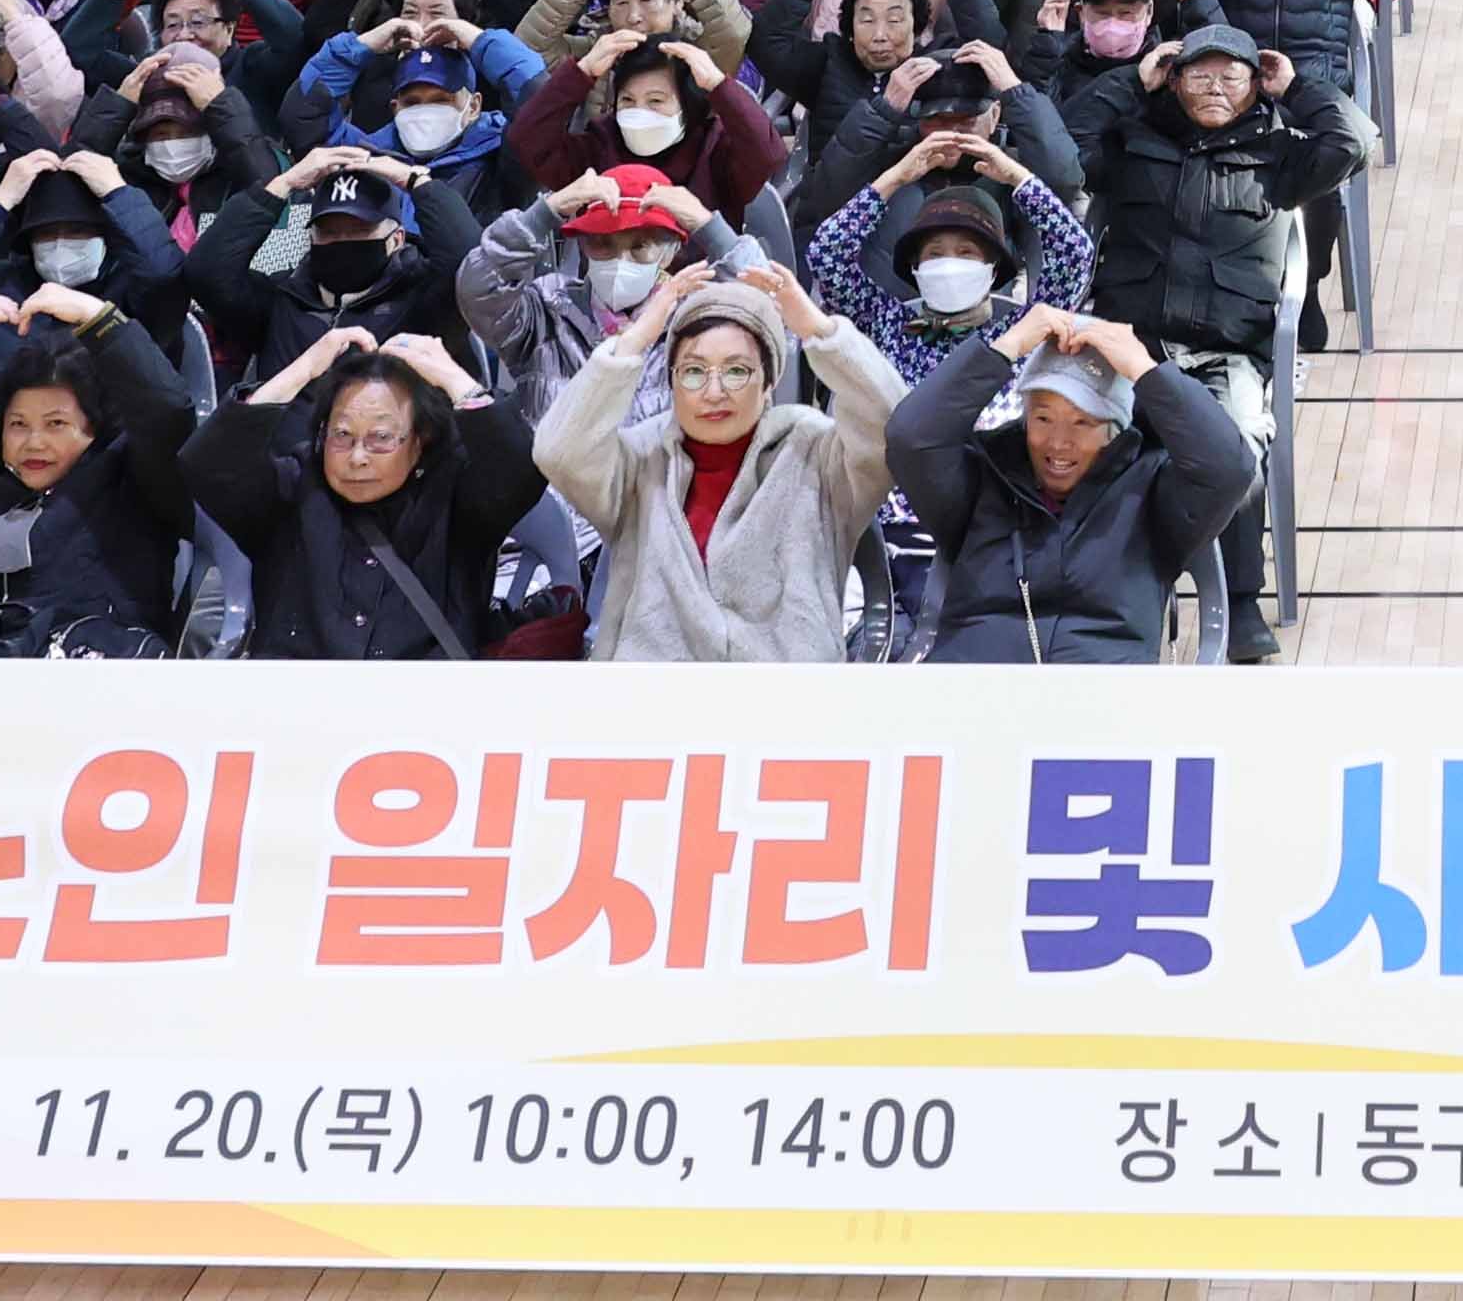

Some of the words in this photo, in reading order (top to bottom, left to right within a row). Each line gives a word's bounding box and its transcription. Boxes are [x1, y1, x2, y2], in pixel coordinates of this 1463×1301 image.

[331, 175, 359, 201] NY
[312, 751, 942, 971] 일자리
[1018, 757, 1216, 977] 및
[35, 1089, 130, 1161] 11.
[164, 1086, 423, 1174] 20.(목)
[467, 1094, 695, 1181] 10:00,
[742, 1097, 956, 1169] 14:00
